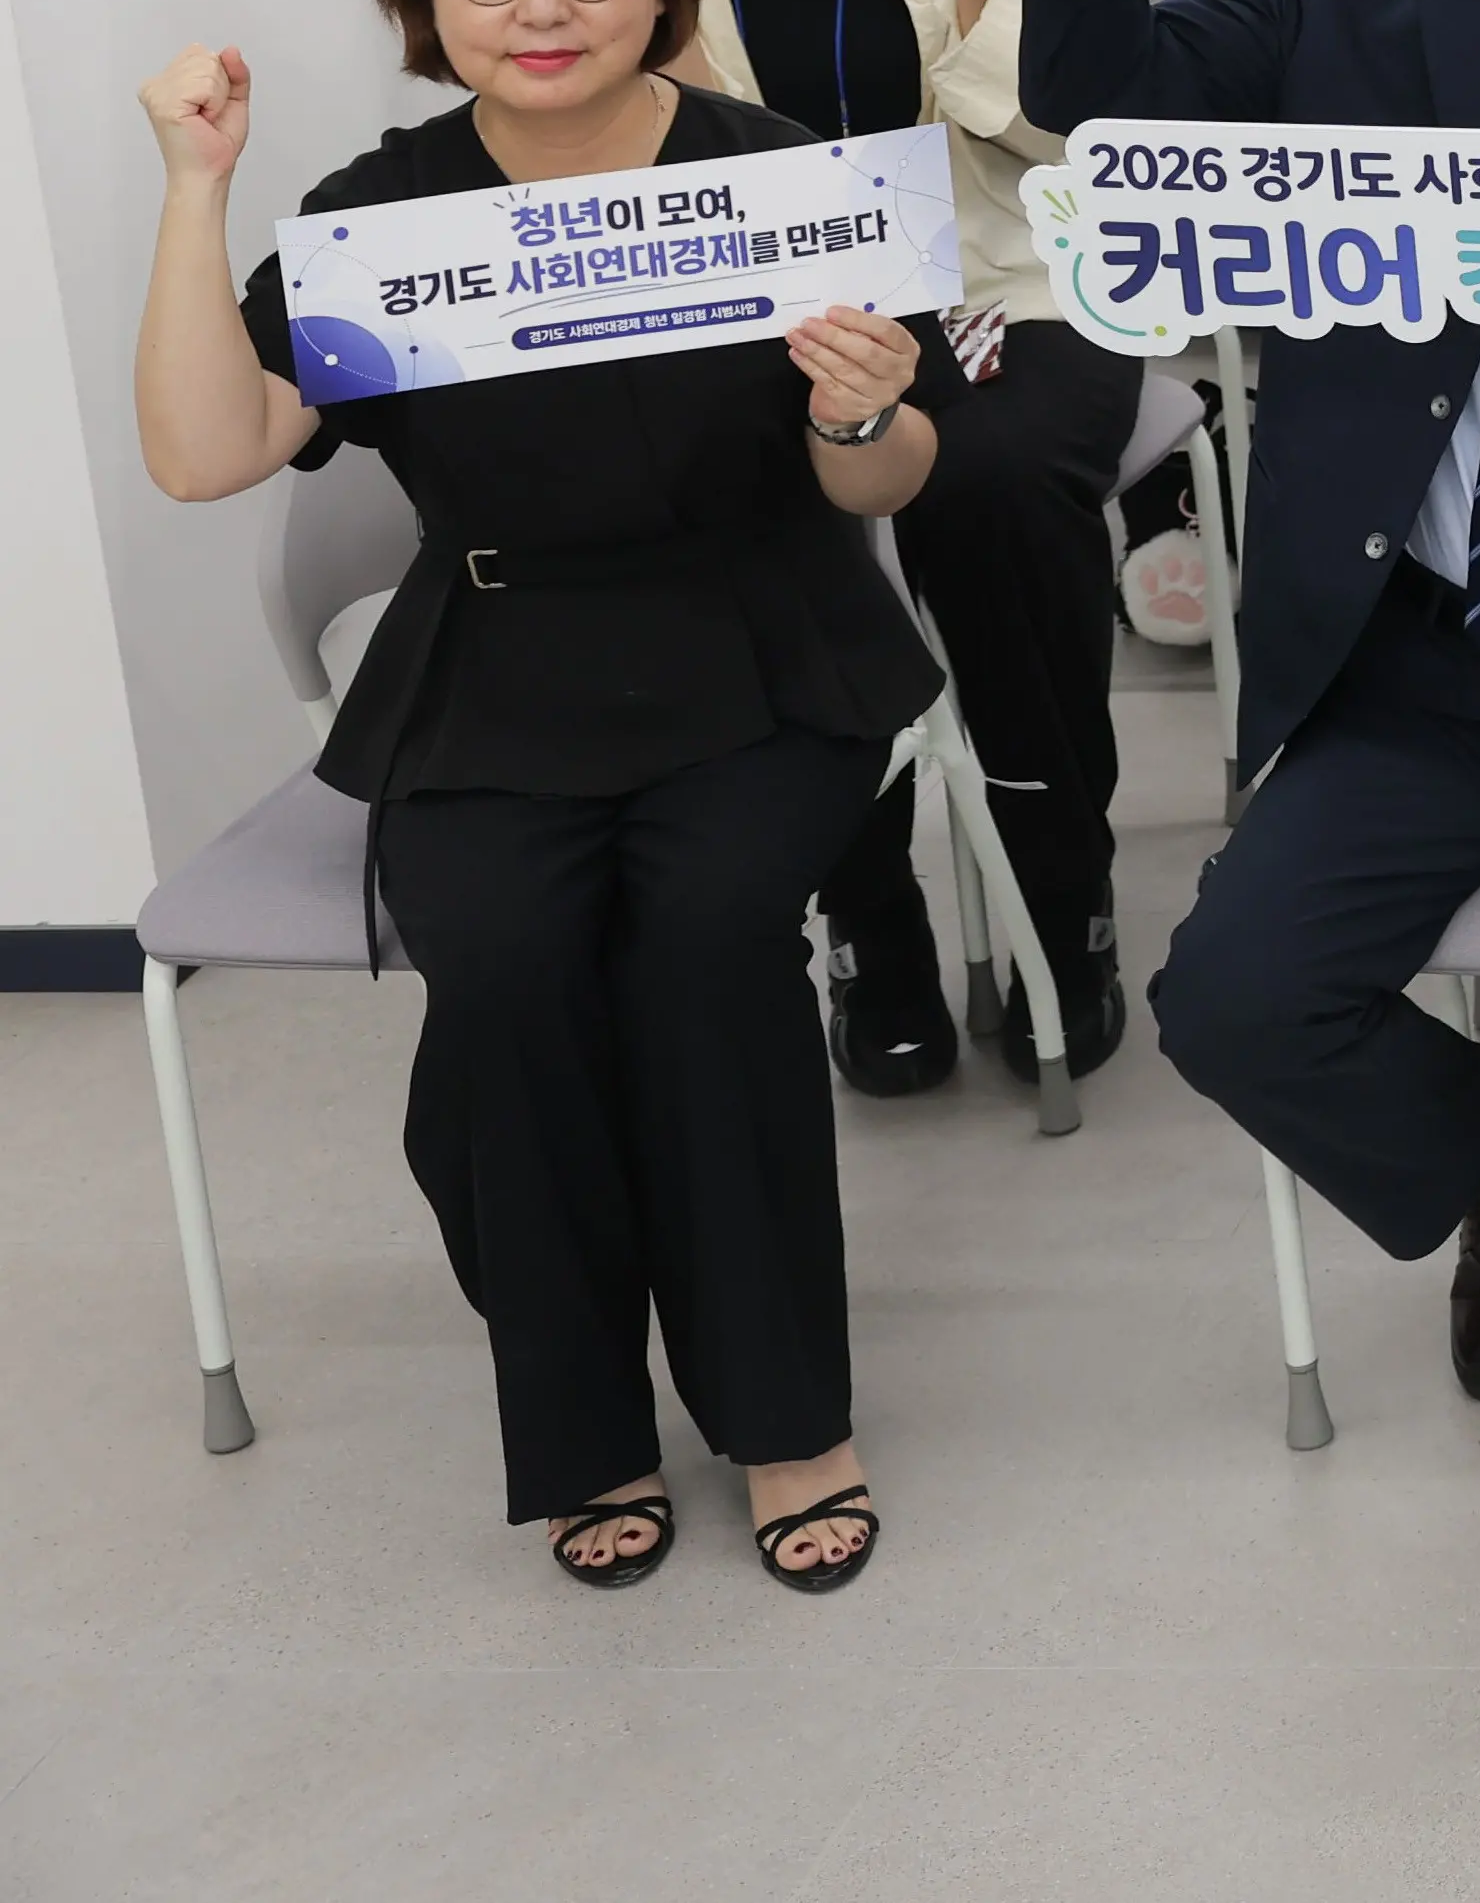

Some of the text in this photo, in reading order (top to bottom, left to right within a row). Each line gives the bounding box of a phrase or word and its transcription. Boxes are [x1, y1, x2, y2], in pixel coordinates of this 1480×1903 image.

[1088, 143, 1227, 193] 2026
[1240, 146, 1400, 202] 경기도
[512, 186, 746, 247] 청년이 모여,
[380, 210, 888, 316] 경기도 사회연대경제를 만들다
[1099, 216, 1422, 323] 커리어
[530, 303, 756, 343] 경기도 사회연대경제 청년 일경험 시범사업
